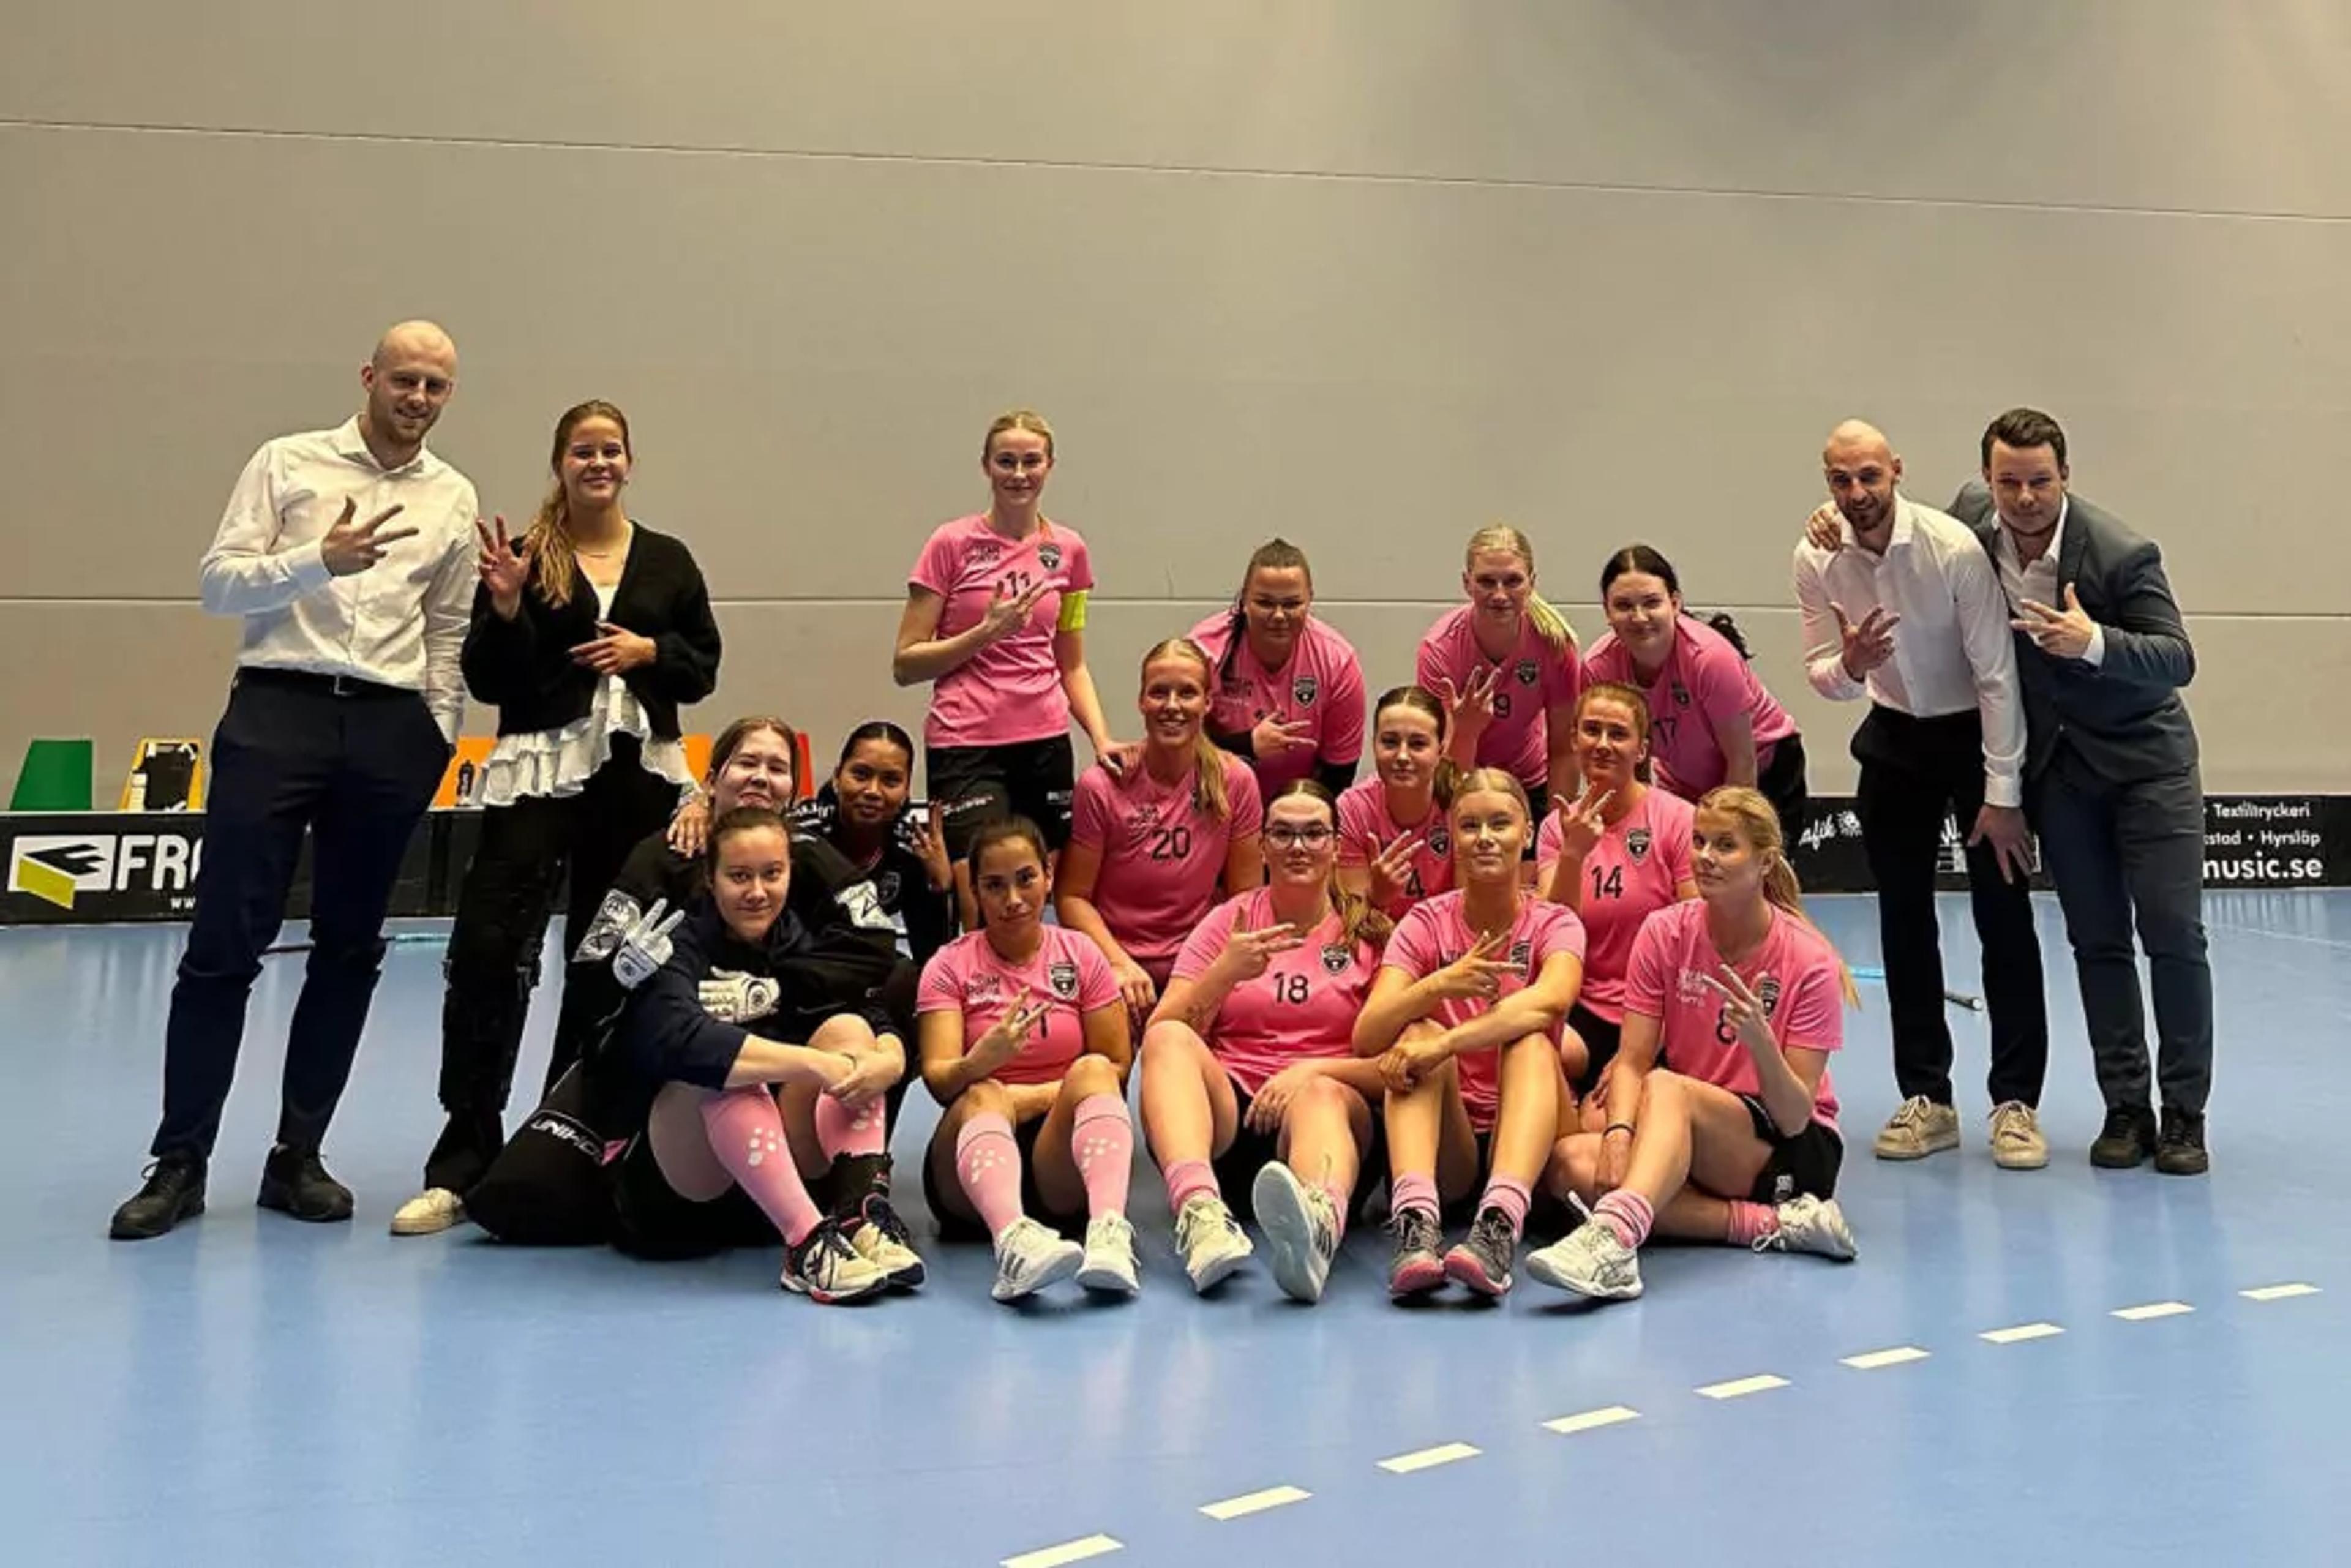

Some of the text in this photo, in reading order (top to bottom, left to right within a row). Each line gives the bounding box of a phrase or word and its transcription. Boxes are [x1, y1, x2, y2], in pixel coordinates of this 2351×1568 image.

[1005, 571, 1031, 598] 11
[1654, 717, 1677, 745] 17
[1152, 827, 1191, 859] 20
[116, 834, 203, 890] FR
[1592, 865, 1623, 899] 14
[1273, 972, 1308, 1005] 18
